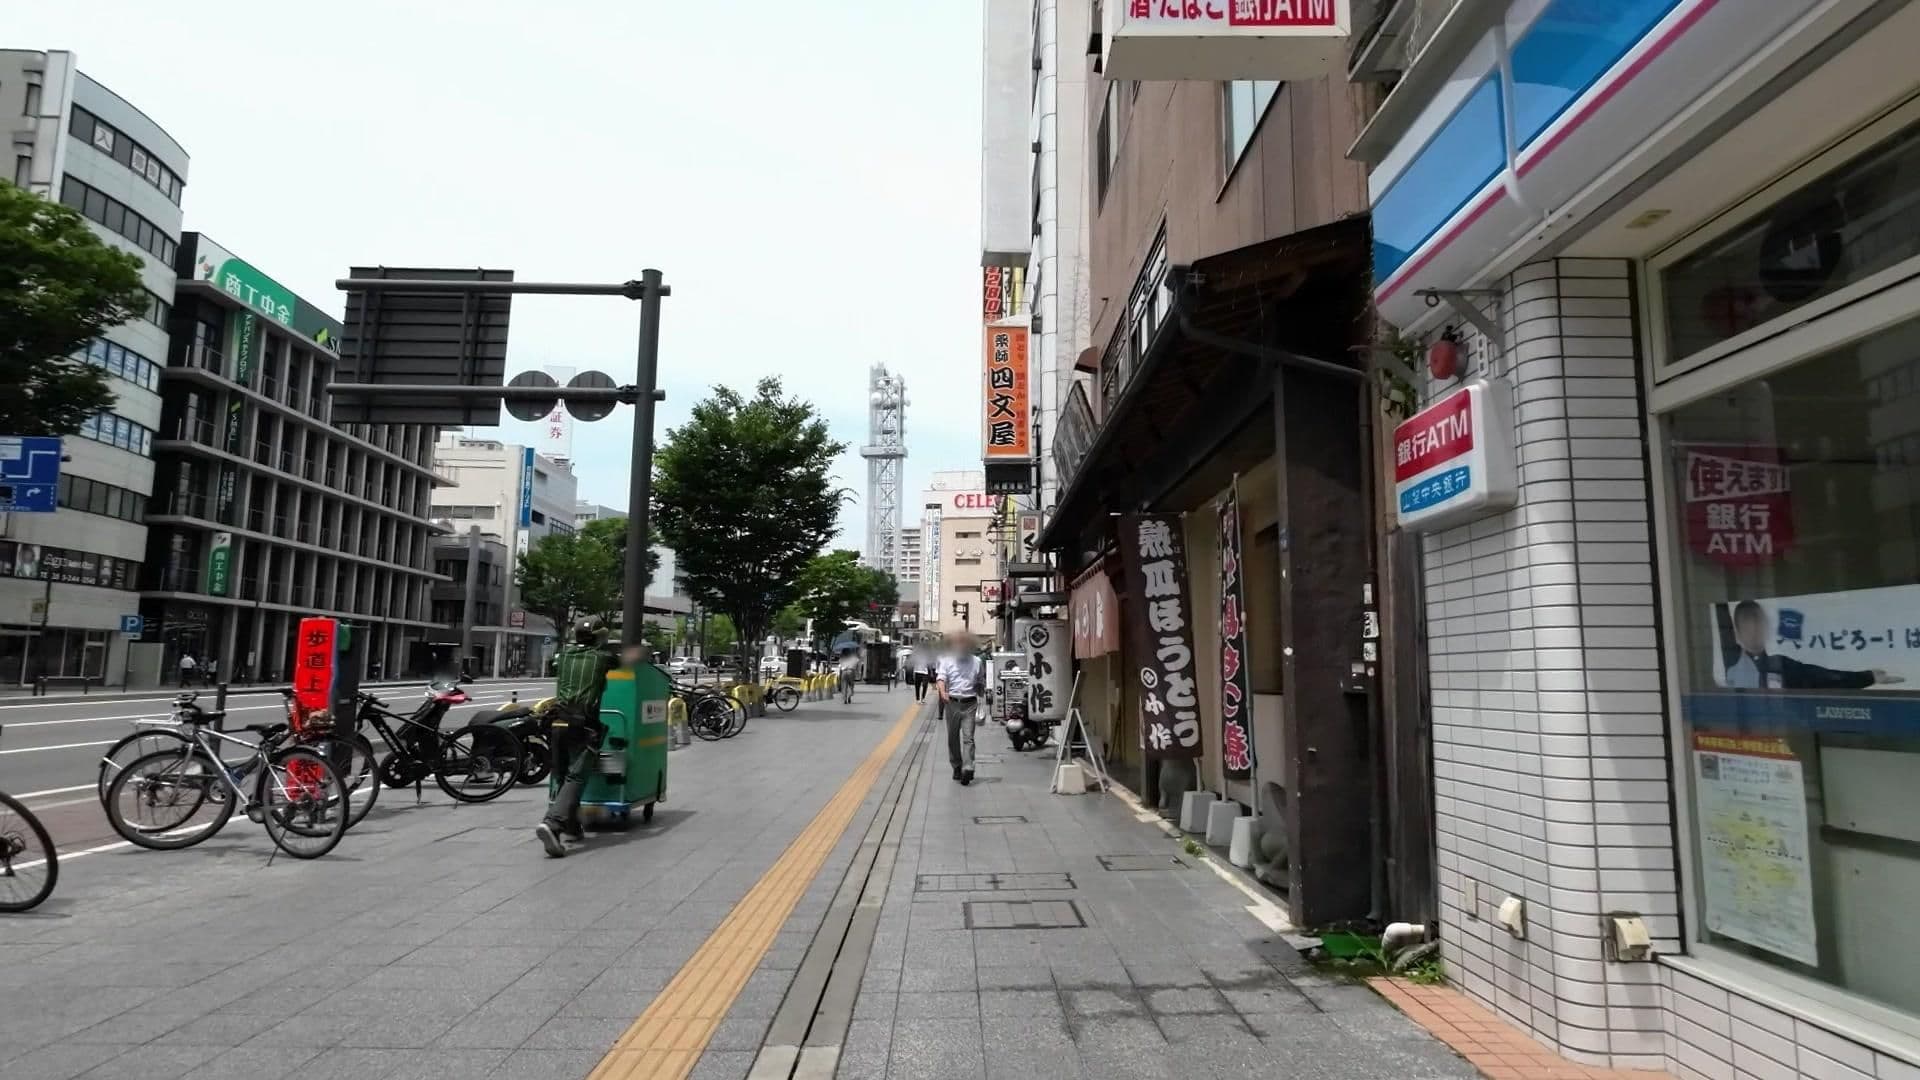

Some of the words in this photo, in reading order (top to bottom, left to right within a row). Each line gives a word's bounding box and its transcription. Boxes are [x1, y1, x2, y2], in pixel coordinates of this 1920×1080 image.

[1235, 0, 1329, 20] 銀行ATM
[990, 366, 1016, 446] 四文屋
[1398, 409, 1468, 467] 銀行ATM
[1706, 503, 1771, 530] 銀行
[1706, 532, 1774, 554] ATM
[304, 630, 329, 694] 歩道上
[1809, 629, 1894, 650] ハピろー!
[1029, 652, 1053, 714] 小作
[1145, 692, 1173, 750] 小作
